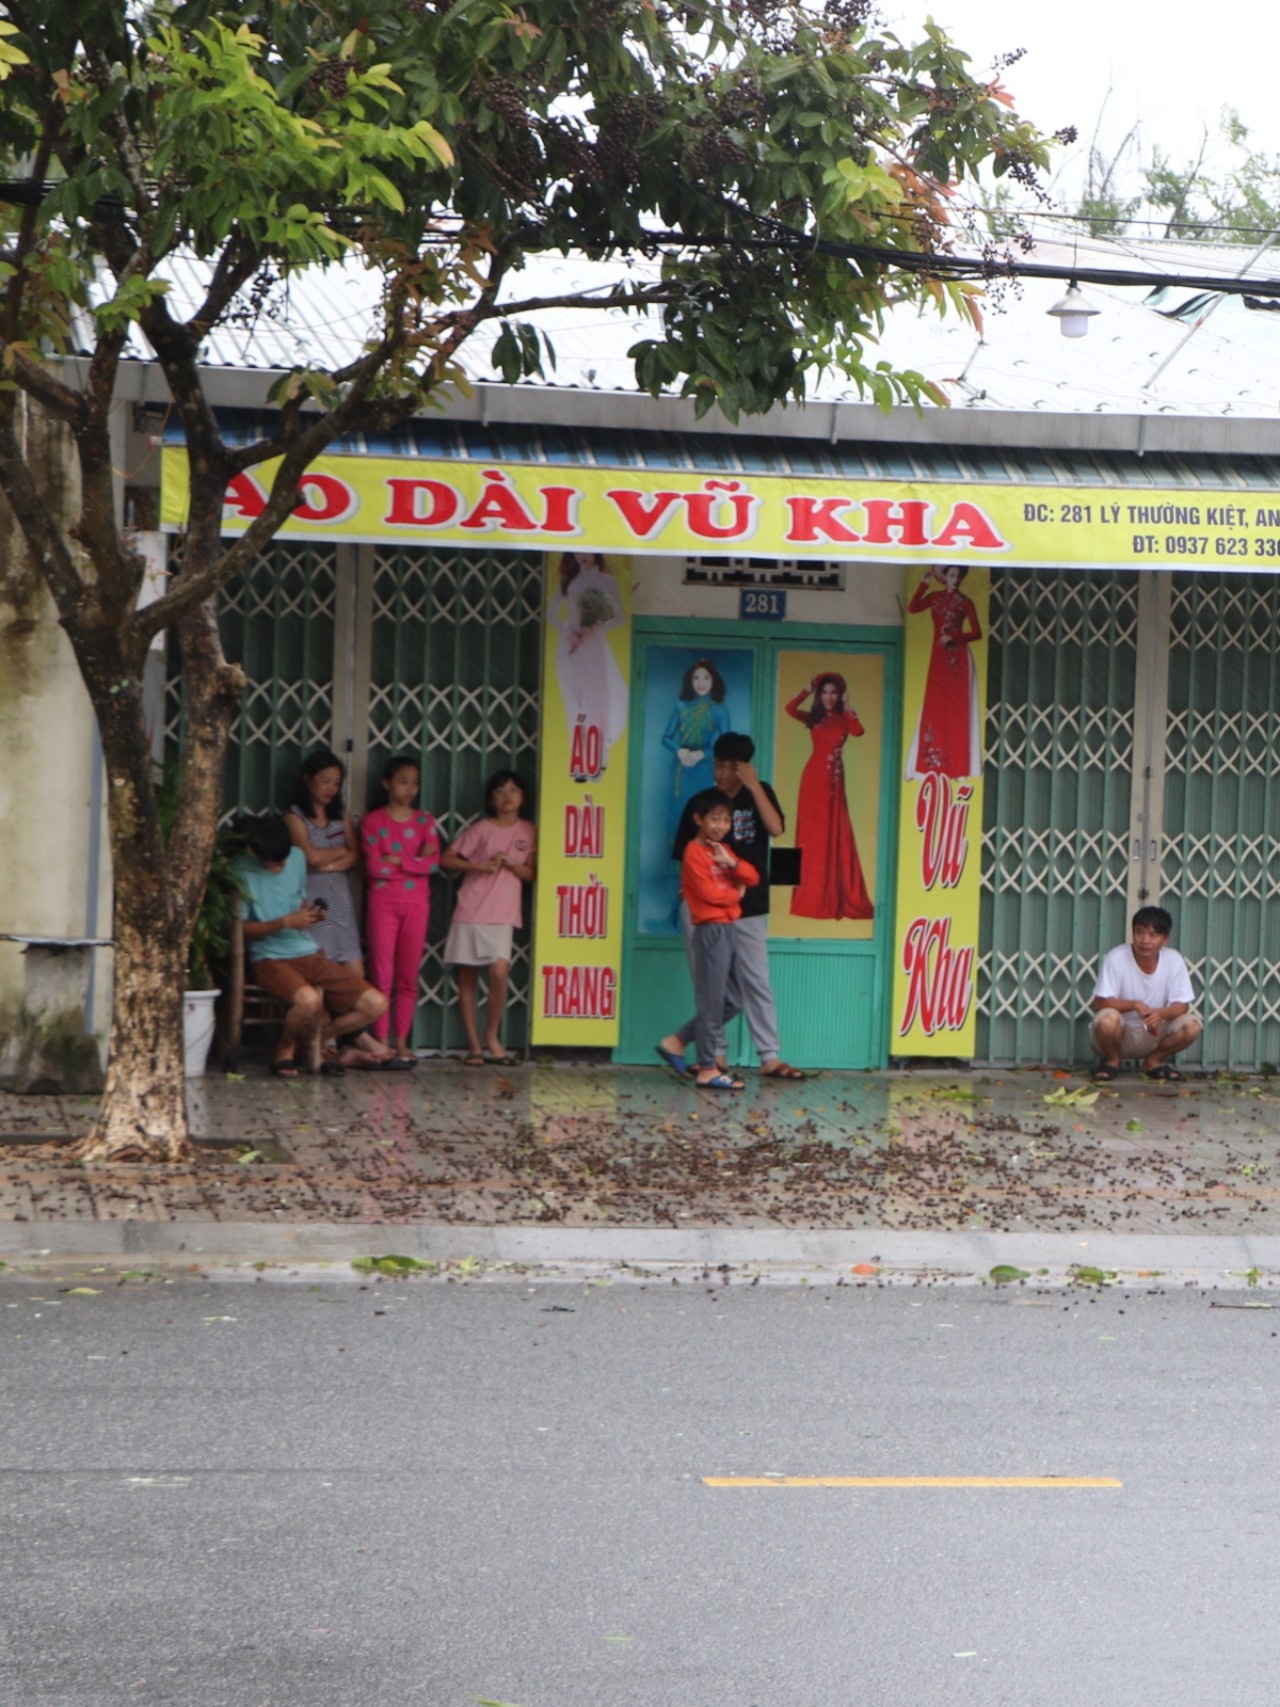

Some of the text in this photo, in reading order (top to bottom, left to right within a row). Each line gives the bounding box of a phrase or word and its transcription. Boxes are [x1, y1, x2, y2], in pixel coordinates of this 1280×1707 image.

[384, 469, 578, 533] DÀI
[606, 479, 756, 539] VŨ
[784, 496, 1006, 550] KHA
[1023, 503, 1055, 523] ĐC:
[1060, 504, 1092, 524] 281
[1100, 501, 1121, 524] LÝ
[1126, 501, 1201, 526] THƯỜNG
[1206, 503, 1250, 531] KIỆT,
[1132, 534, 1159, 554] ĐT:
[1165, 535, 1210, 556] 0937
[1215, 537, 1249, 557] 623
[745, 593, 780, 614] 281
[568, 712, 604, 778] ÁO
[563, 792, 605, 859] DÀI
[915, 769, 974, 891] Vũ
[555, 871, 609, 938] THỜI
[541, 964, 617, 1019] TRANG
[898, 914, 974, 1037] Kha
